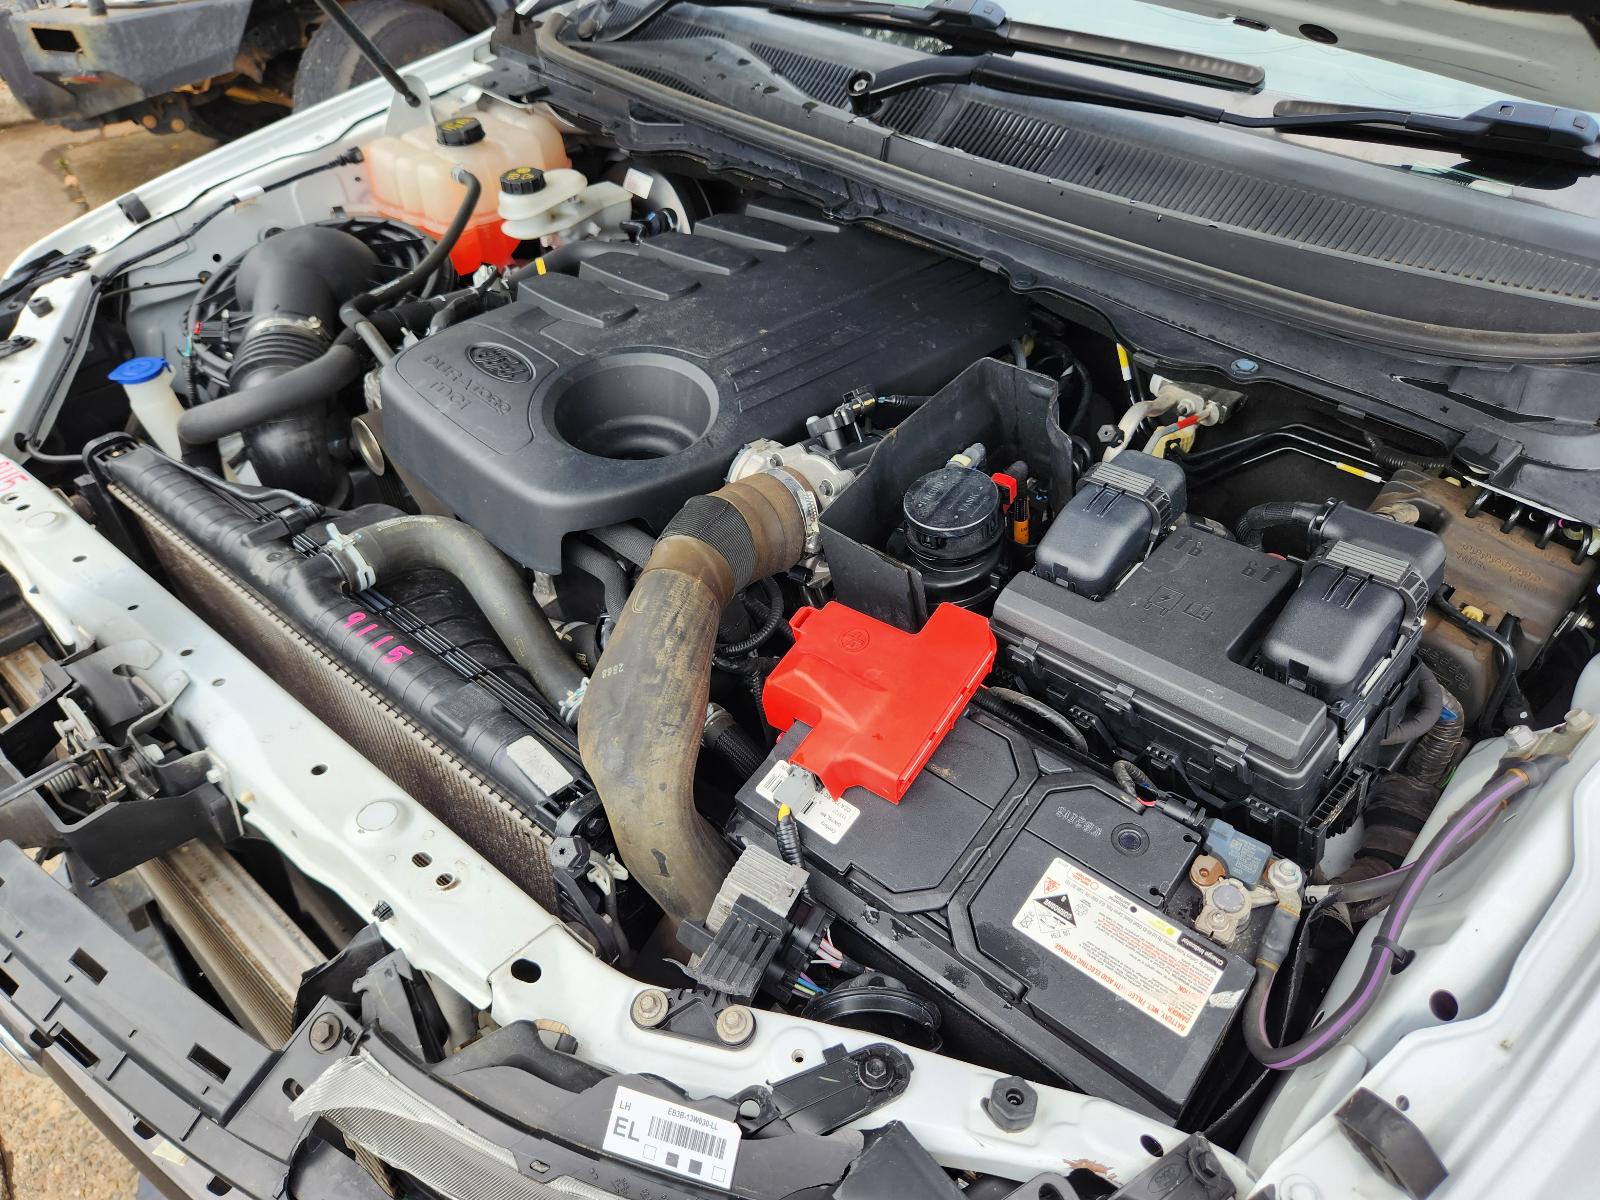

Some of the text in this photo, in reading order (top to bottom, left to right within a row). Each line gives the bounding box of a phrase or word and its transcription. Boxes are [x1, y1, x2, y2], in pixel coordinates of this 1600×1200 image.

[1041, 897, 1073, 920] CORROSIVE
[1179, 935, 1225, 967] Charge Indicator
[619, 1099, 632, 1111] LH
[613, 1115, 640, 1142] EL
